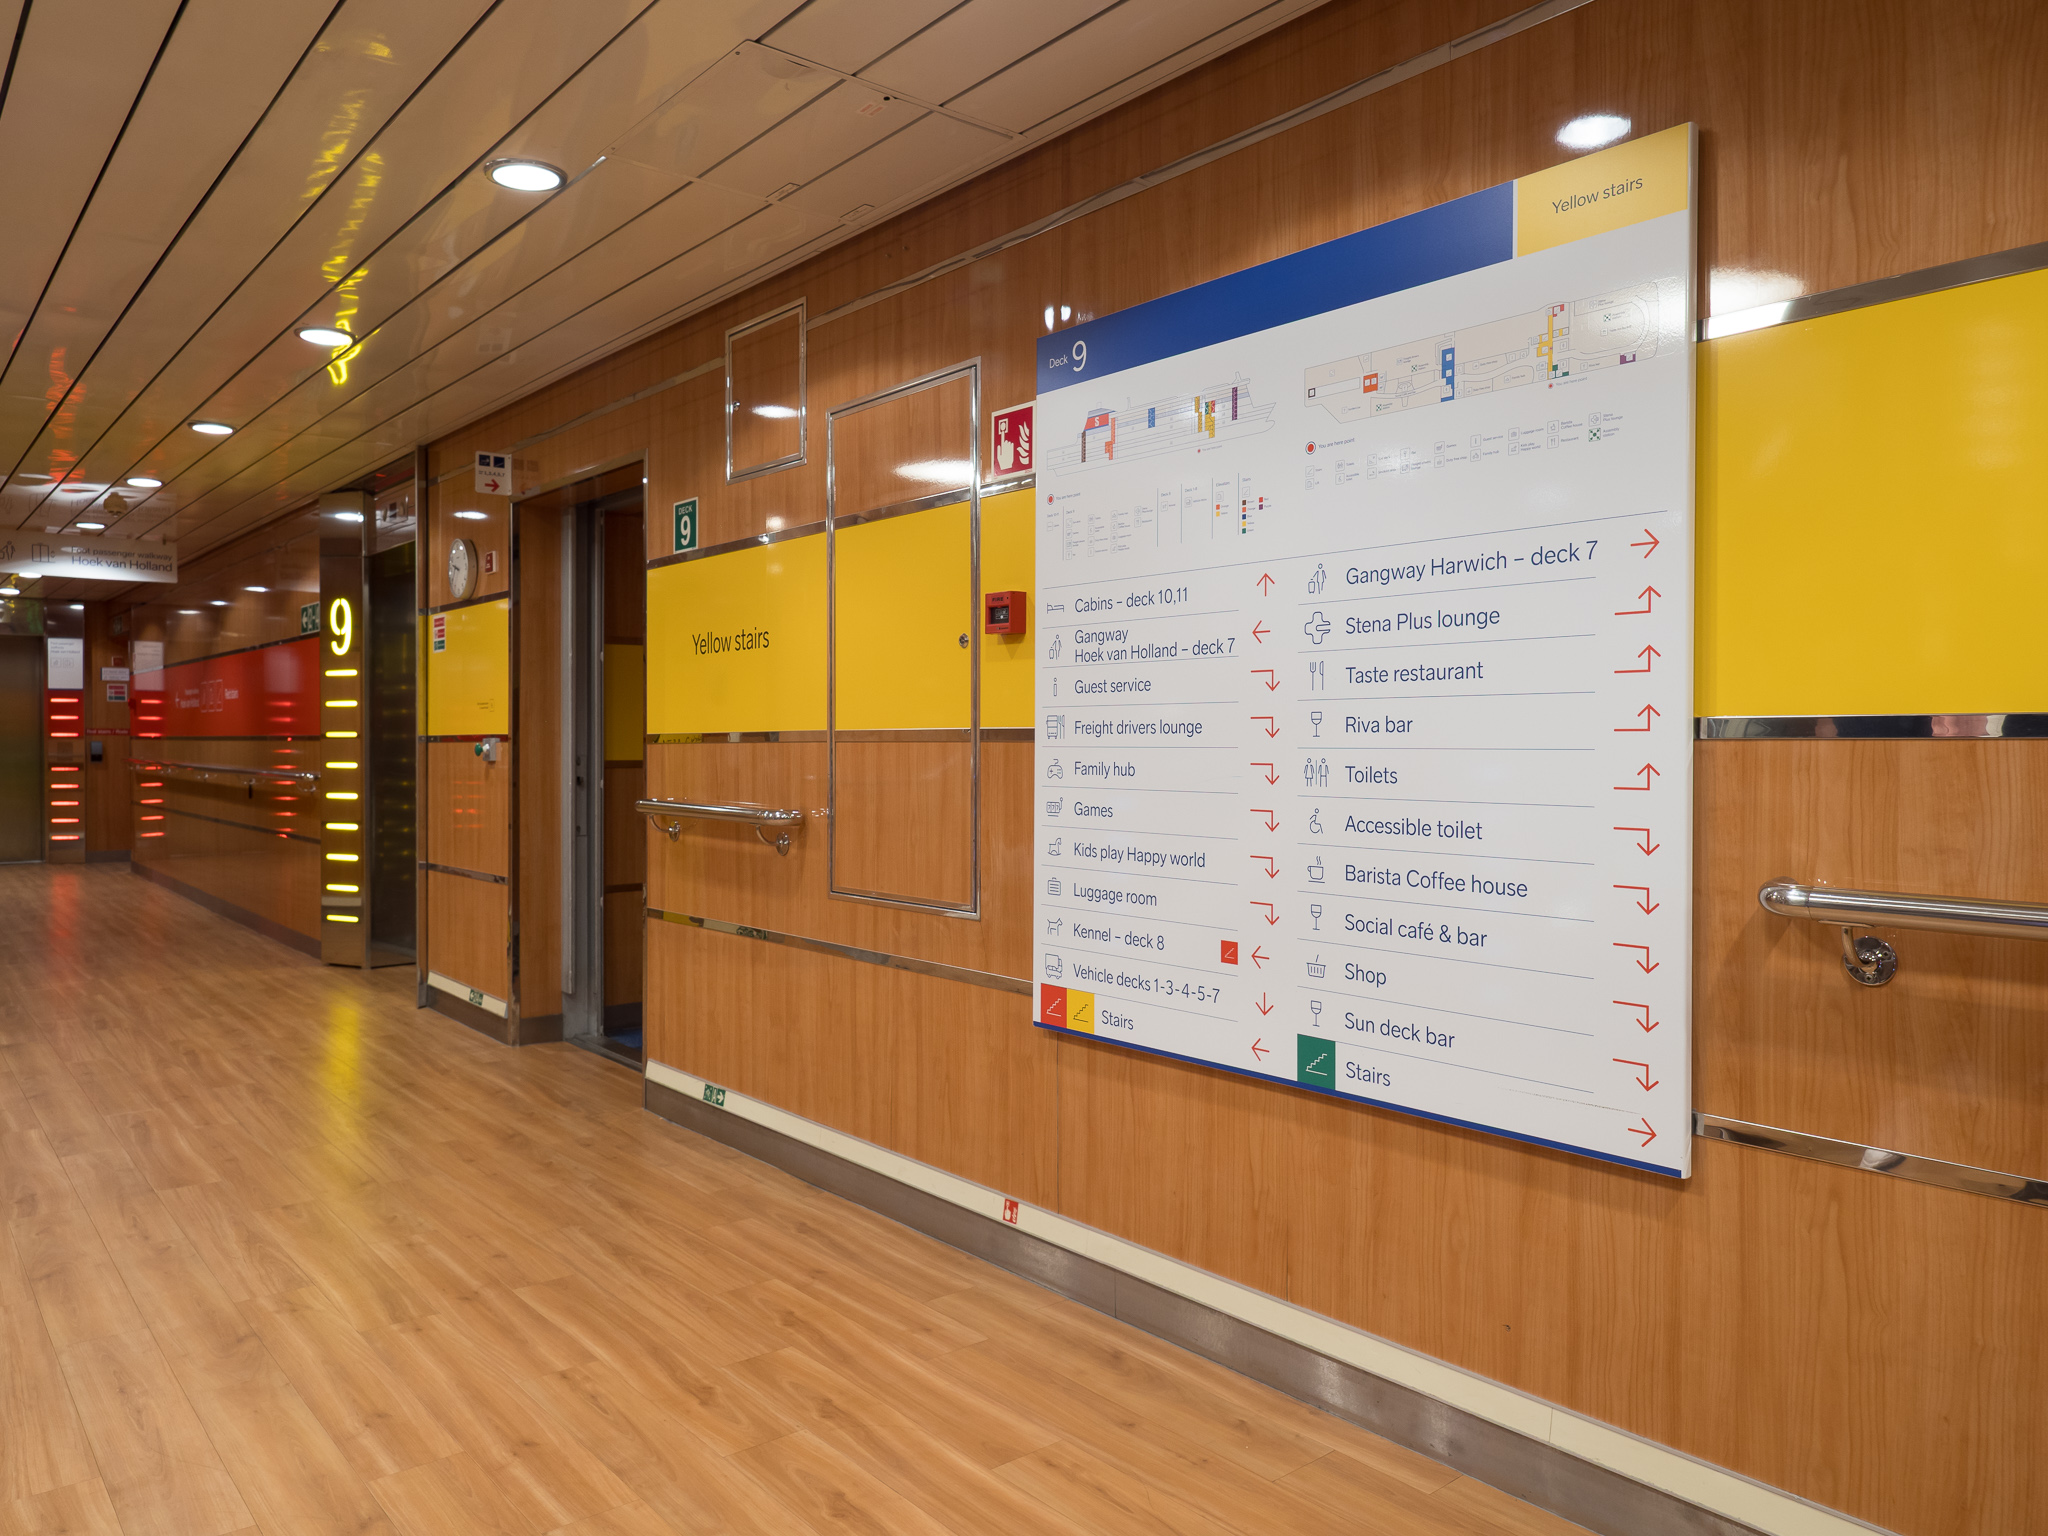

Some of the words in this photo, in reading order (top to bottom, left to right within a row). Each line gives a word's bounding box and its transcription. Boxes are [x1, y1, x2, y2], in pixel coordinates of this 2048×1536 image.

[1552, 192, 1599, 214] Yellow
[1602, 178, 1643, 200] stairs
[1050, 354, 1068, 368] Deck
[1072, 340, 1086, 372] 9
[678, 504, 693, 515] DECK
[680, 515, 691, 546] 9
[72, 556, 103, 567] Hoek
[106, 559, 126, 569] van
[130, 560, 172, 572] Holland
[92, 549, 135, 559] passenger
[137, 552, 172, 562] walkway
[1346, 562, 1426, 584] Gangway
[1431, 551, 1507, 576] Harwich
[1531, 543, 1580, 565] deck
[1586, 540, 1598, 560] 7
[1074, 597, 1113, 613] Cabins
[1126, 591, 1155, 607] deck
[1158, 587, 1188, 605] 10,11
[330, 598, 352, 655] 9
[1345, 617, 1391, 635] Stena
[1397, 611, 1432, 631] Plus
[1438, 607, 1500, 630] lounge
[692, 631, 732, 655] Yellow
[734, 627, 769, 651] stairs
[1074, 628, 1128, 645] Gangway
[1074, 647, 1104, 663] Hoek
[1107, 649, 1127, 661] van
[1130, 642, 1177, 659] Holland
[1192, 638, 1224, 655] deck
[1228, 638, 1235, 653] 7
[1345, 665, 1389, 684] Taste
[1394, 661, 1483, 683] restaurant
[1074, 679, 1108, 694] Guest
[1110, 678, 1151, 693] service
[1074, 720, 1113, 737] Freight
[1116, 720, 1156, 734] drivers
[1159, 719, 1202, 738] lounge
[1345, 717, 1380, 733] Riva
[1385, 715, 1413, 733] bar
[1074, 761, 1110, 779] Family
[1113, 762, 1136, 776] hub
[1345, 765, 1398, 785] Toilets
[1074, 802, 1113, 817] Games
[1345, 815, 1432, 837] Accessible
[1437, 820, 1482, 840] toilet
[1074, 842, 1097, 858] Kids
[1100, 844, 1124, 862] play
[1127, 847, 1167, 867] Happy
[1170, 853, 1206, 868] world
[1345, 864, 1401, 886] Barista
[1406, 870, 1465, 892] Coffee
[1471, 875, 1528, 897] house
[1074, 882, 1123, 904] Luggage
[1126, 892, 1157, 907] room
[1074, 923, 1111, 942] Kennel
[1124, 931, 1154, 949] deck
[1157, 935, 1165, 951] 8
[1345, 914, 1393, 936] Social
[1398, 922, 1434, 942] café
[1439, 924, 1452, 943] &
[1457, 926, 1487, 947] bar
[1073, 963, 1114, 984] Vehicle
[1116, 972, 1151, 992] decks
[1154, 978, 1220, 1004] 1-3-4-5-7
[1345, 963, 1387, 986] Shop
[1102, 1010, 1134, 1030] Stairs
[1345, 1012, 1375, 1033] Sun
[1380, 1018, 1420, 1042] deck
[1426, 1026, 1455, 1048] bar
[1345, 1061, 1391, 1087] Stairs
